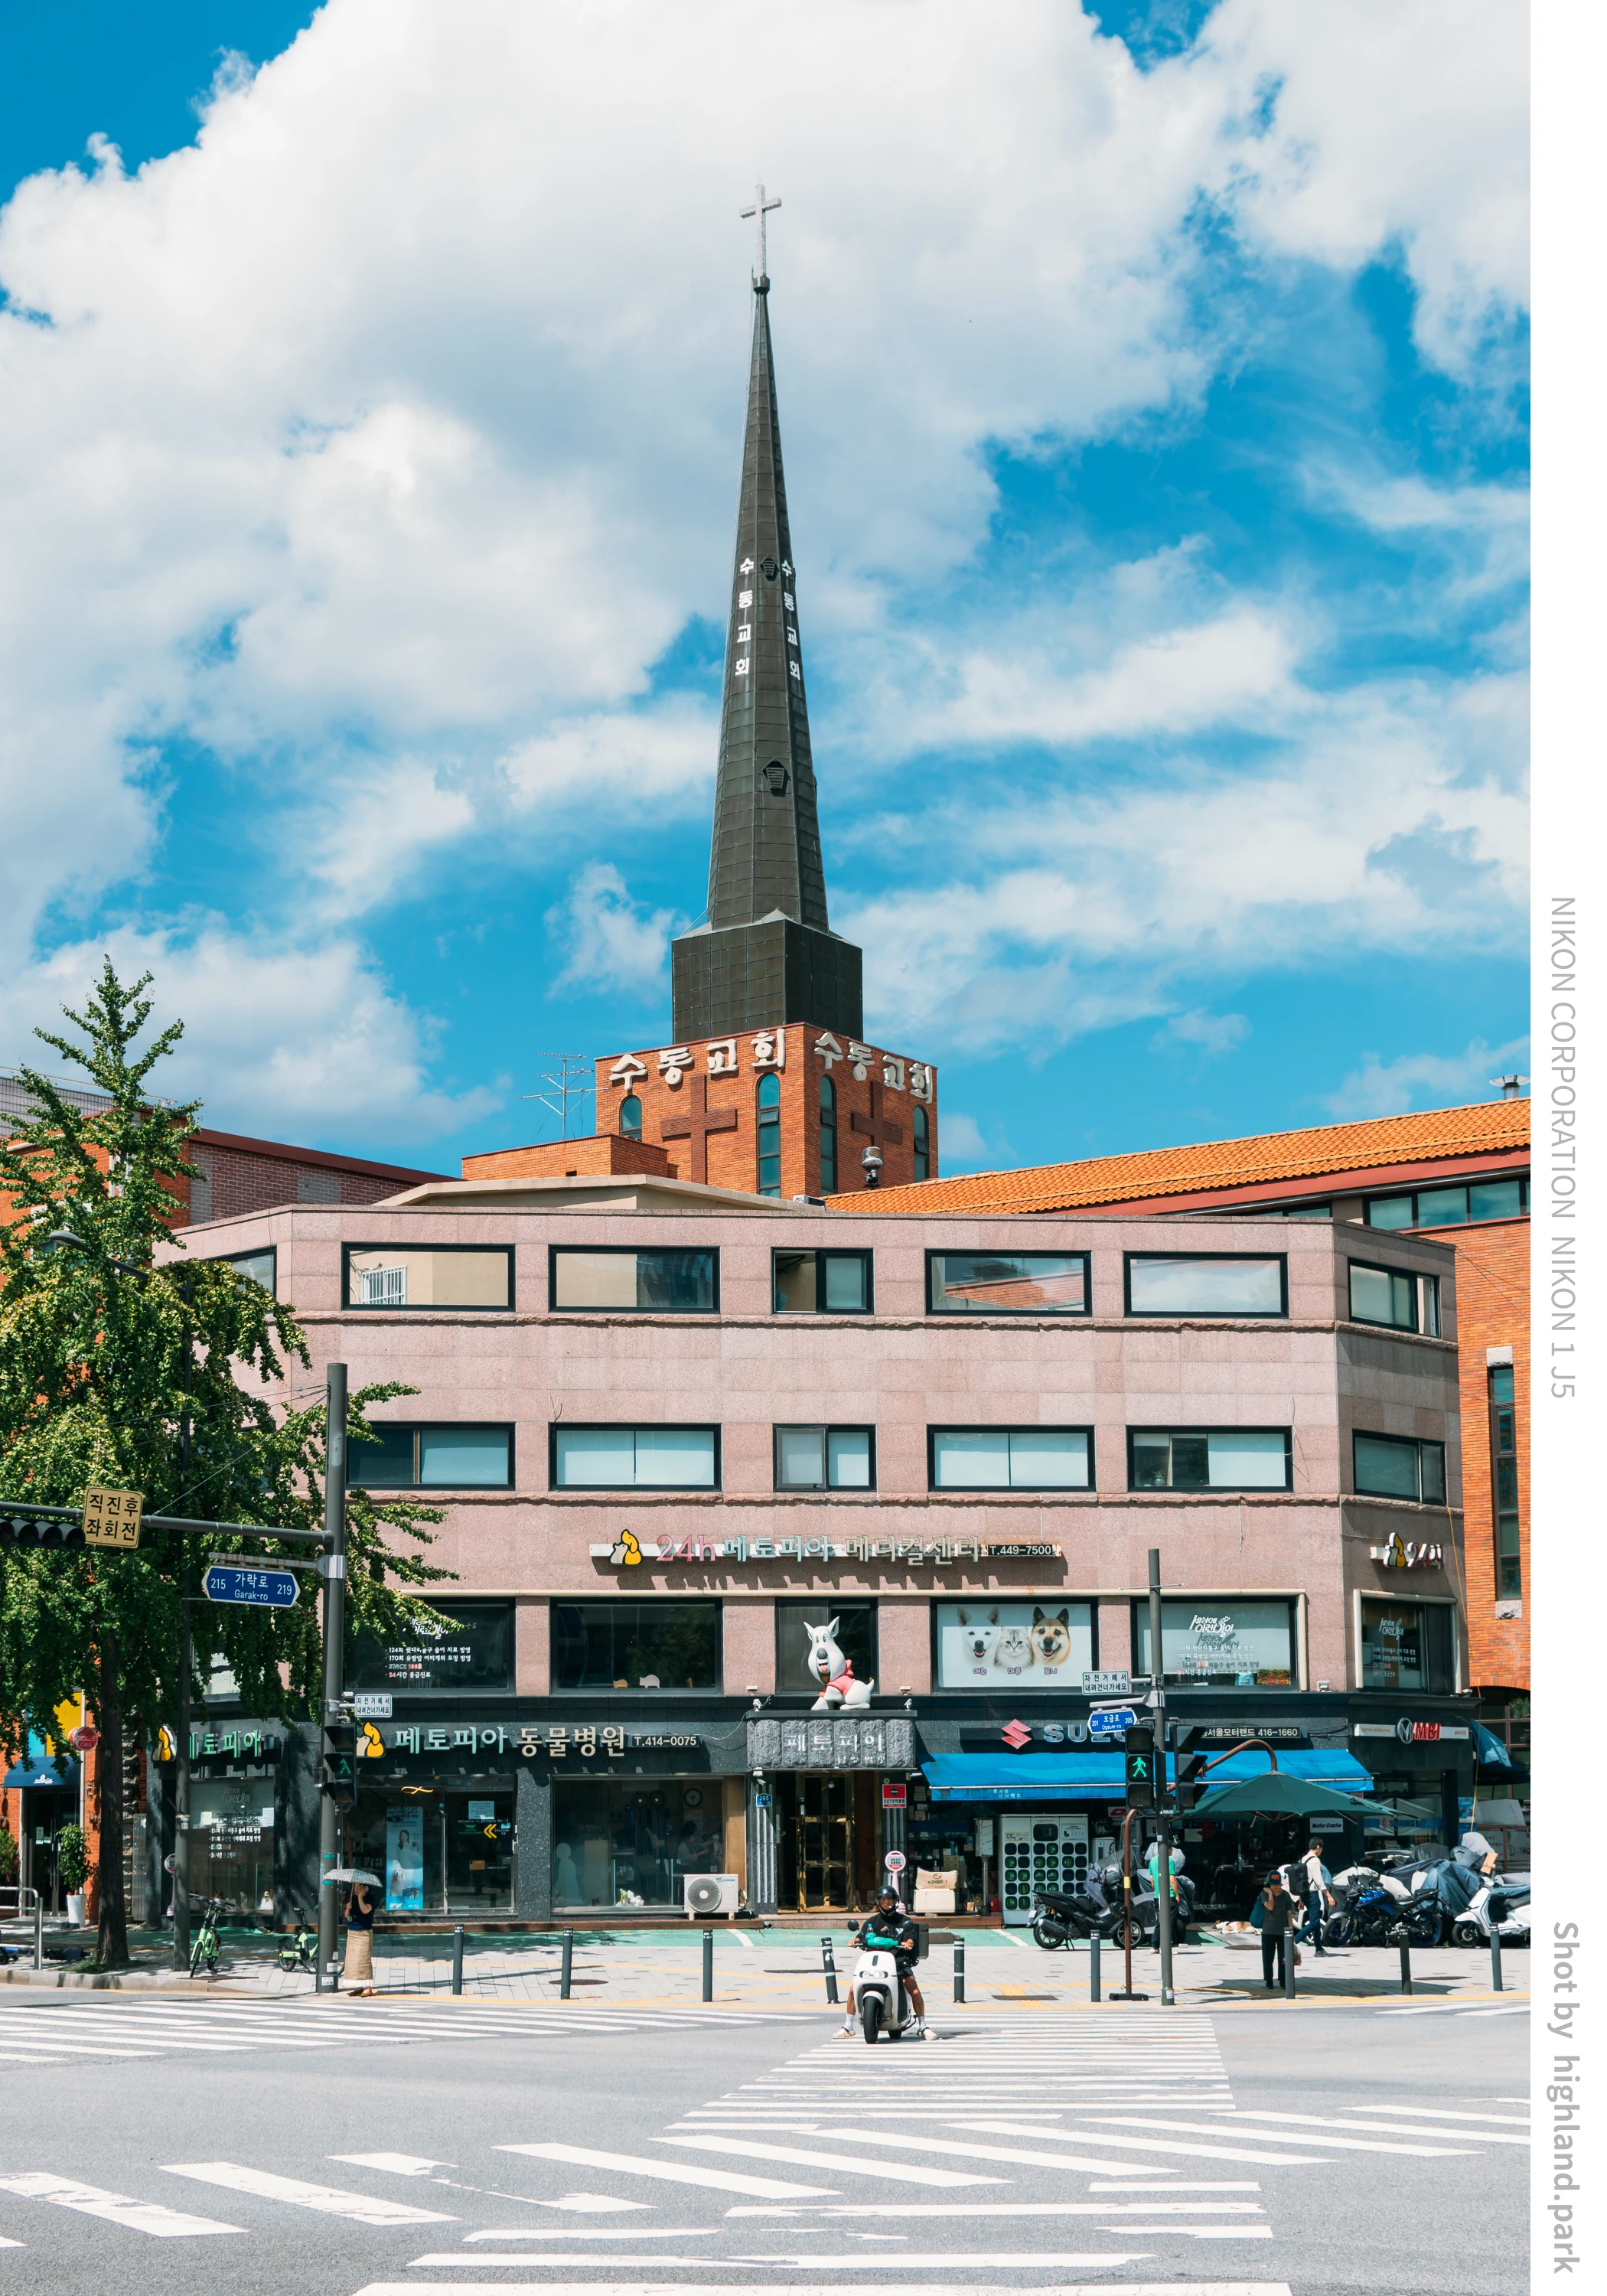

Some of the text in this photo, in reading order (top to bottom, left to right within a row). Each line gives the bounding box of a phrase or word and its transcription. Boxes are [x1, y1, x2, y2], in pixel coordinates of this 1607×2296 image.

[735, 558, 754, 676] 수동교회
[781, 560, 800, 680] 수동교회
[609, 1029, 785, 1091] 수동교회
[814, 1032, 933, 1104] 수동교회
[90, 1494, 138, 1517] 직진후
[86, 1518, 135, 1541] 좌회전
[656, 1534, 1052, 1566] 24h 페토피아 메디컬센터 T.449-7500
[210, 1573, 292, 1596] 215 가락로 219
[234, 1589, 268, 1600] Garak-ro
[1085, 1683, 1126, 1691] 내려건너가세요
[1103, 1714, 1120, 1723] 오금로
[395, 1726, 697, 1757] 페토피아 동물병원 T.414-0075
[785, 1734, 882, 1752] 페토피아
[1258, 1728, 1298, 1737] 416-1660
